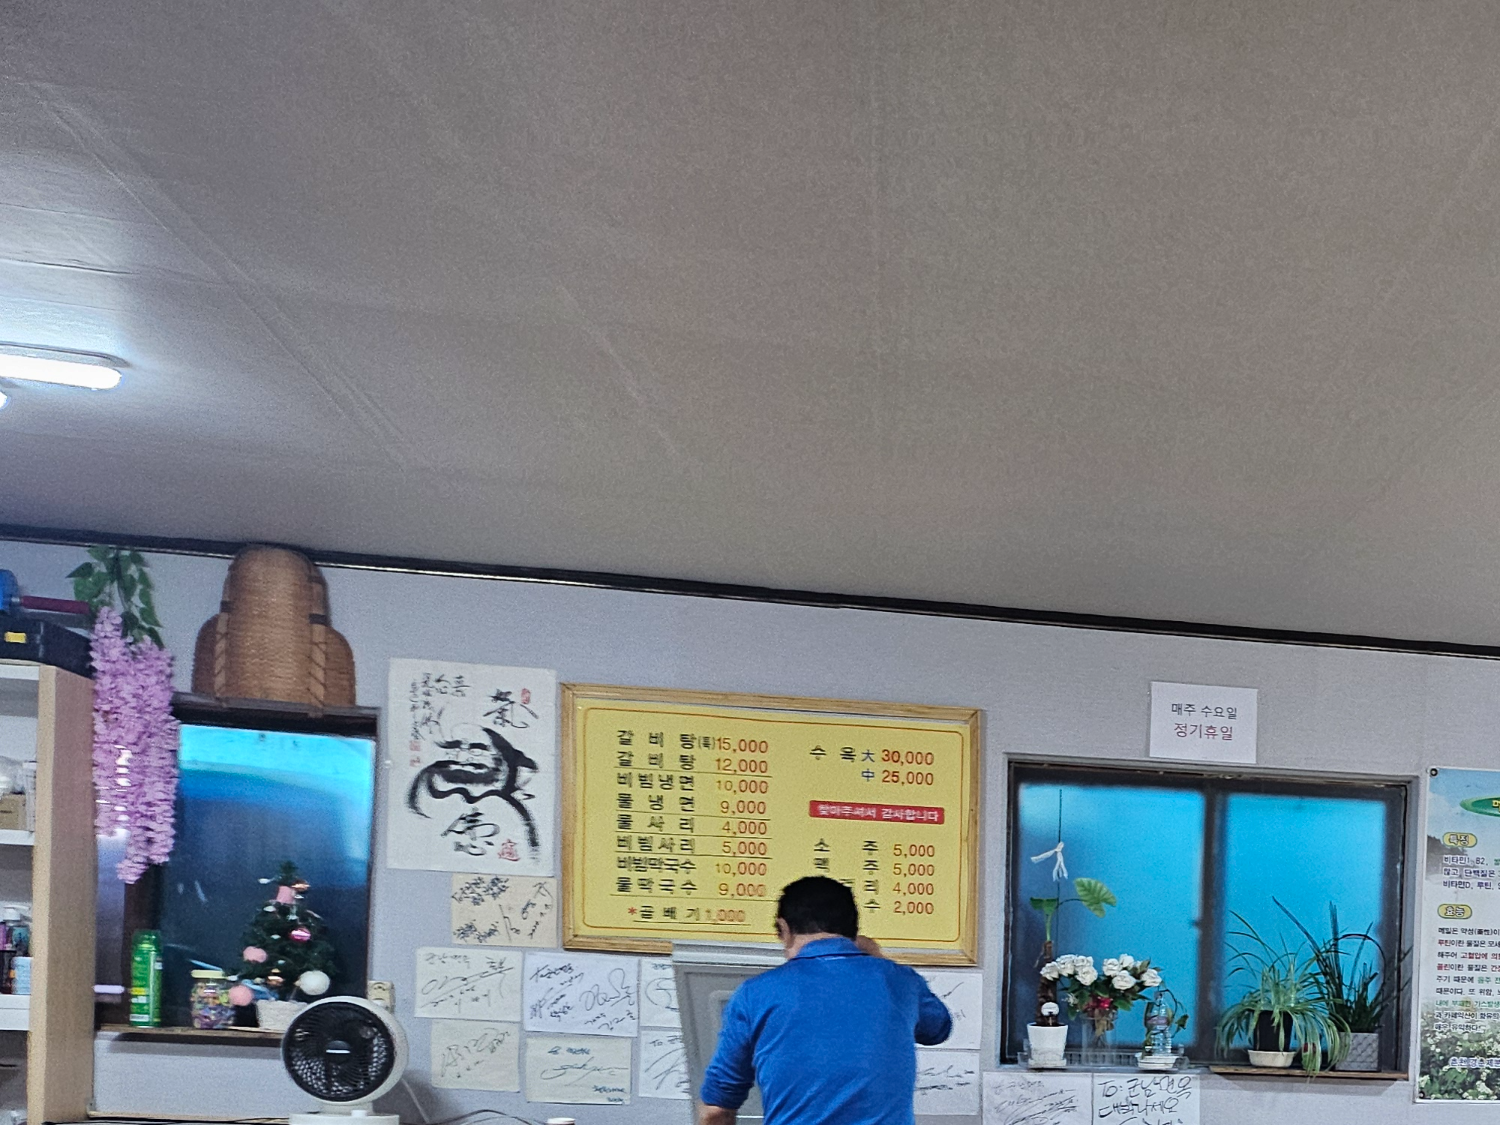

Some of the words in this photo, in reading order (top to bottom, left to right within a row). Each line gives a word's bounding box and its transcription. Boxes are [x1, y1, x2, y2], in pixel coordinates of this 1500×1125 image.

[1171, 703, 1196, 716] 매주
[1200, 705, 1237, 720] 수요일
[1174, 722, 1233, 741] 정기휴일
[716, 736, 769, 754] 15,000
[881, 749, 935, 766] 30,000
[715, 758, 768, 774] 12,000
[881, 769, 934, 786] 25,000
[716, 779, 769, 795] 10,000
[720, 800, 767, 815] 9,000
[722, 820, 768, 835] 4,000
[721, 841, 768, 856] 5,000
[892, 843, 935, 858] 5,000
[715, 862, 768, 877] 10,000
[892, 862, 935, 877] 5,000
[718, 882, 767, 898] 9,000
[892, 881, 935, 897] 4,000
[893, 900, 935, 915] 2,000
